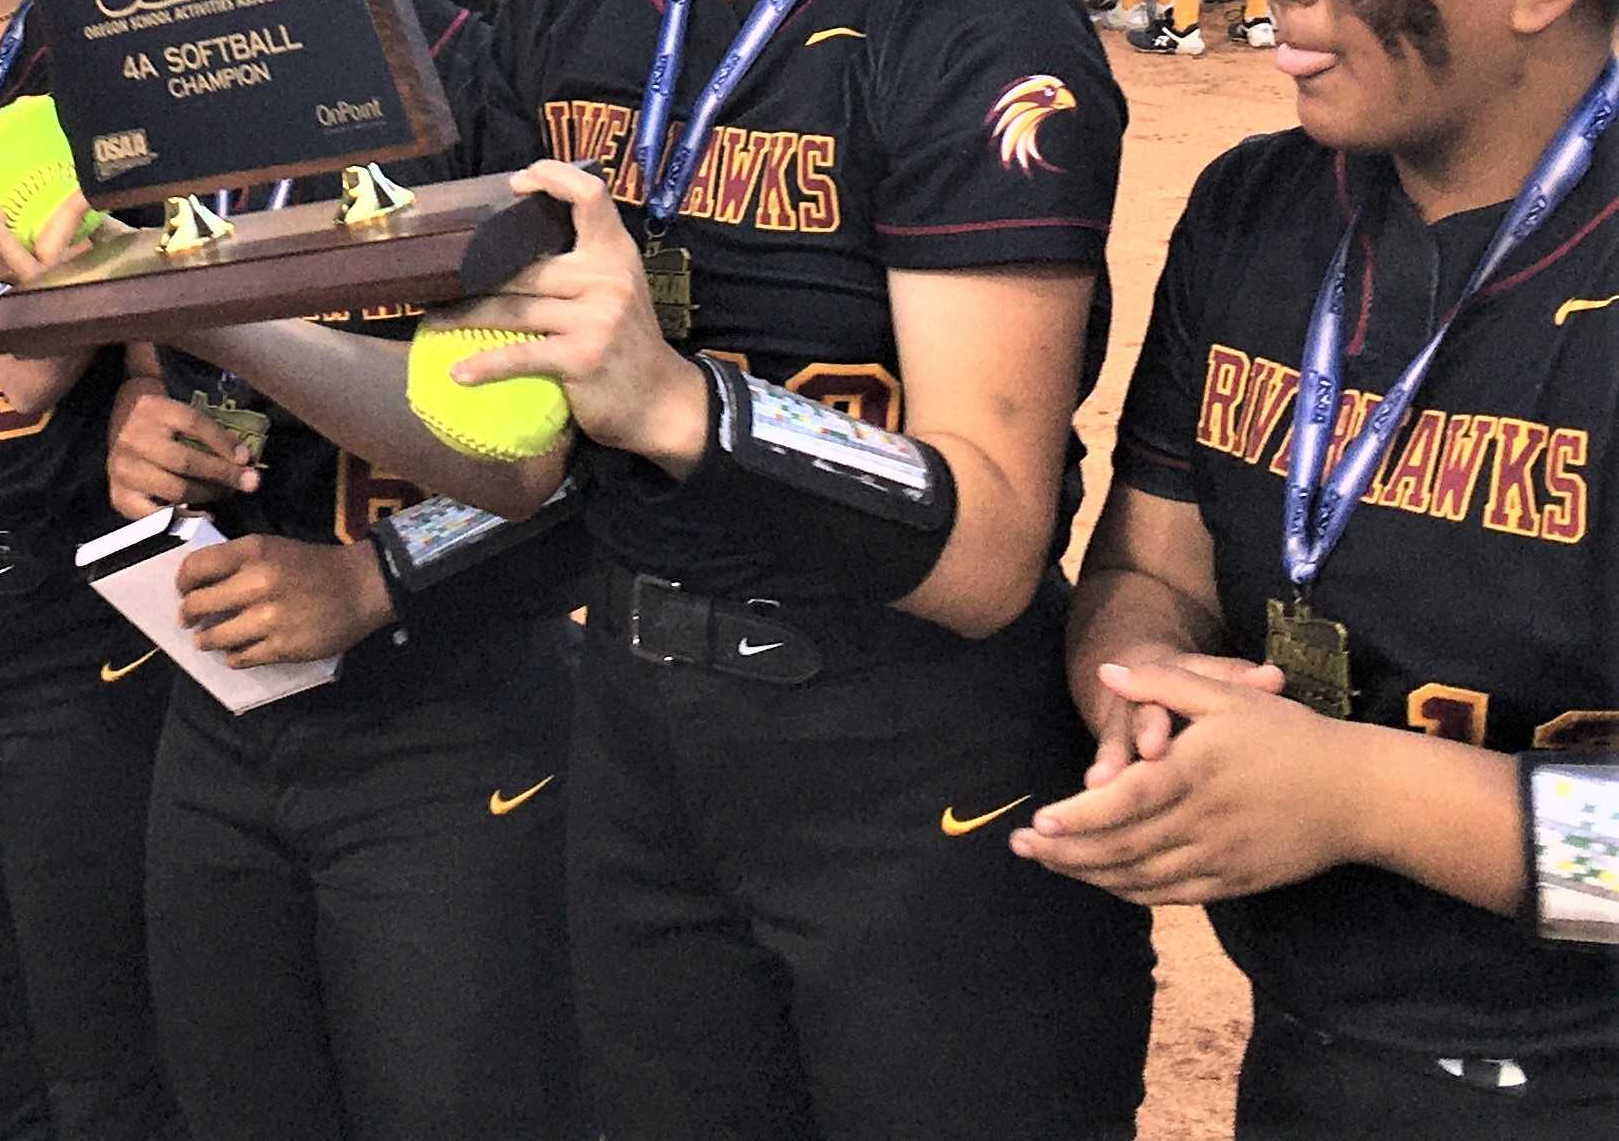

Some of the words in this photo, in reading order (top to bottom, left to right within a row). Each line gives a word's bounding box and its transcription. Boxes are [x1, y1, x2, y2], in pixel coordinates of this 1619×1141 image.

[129, 8, 173, 31] SCHOOL
[123, 52, 160, 80] 4A
[163, 24, 303, 73] SOFTBALL
[167, 61, 272, 98] CHAMPION
[316, 98, 383, 126] OnPoint
[92, 131, 148, 163] OSAA
